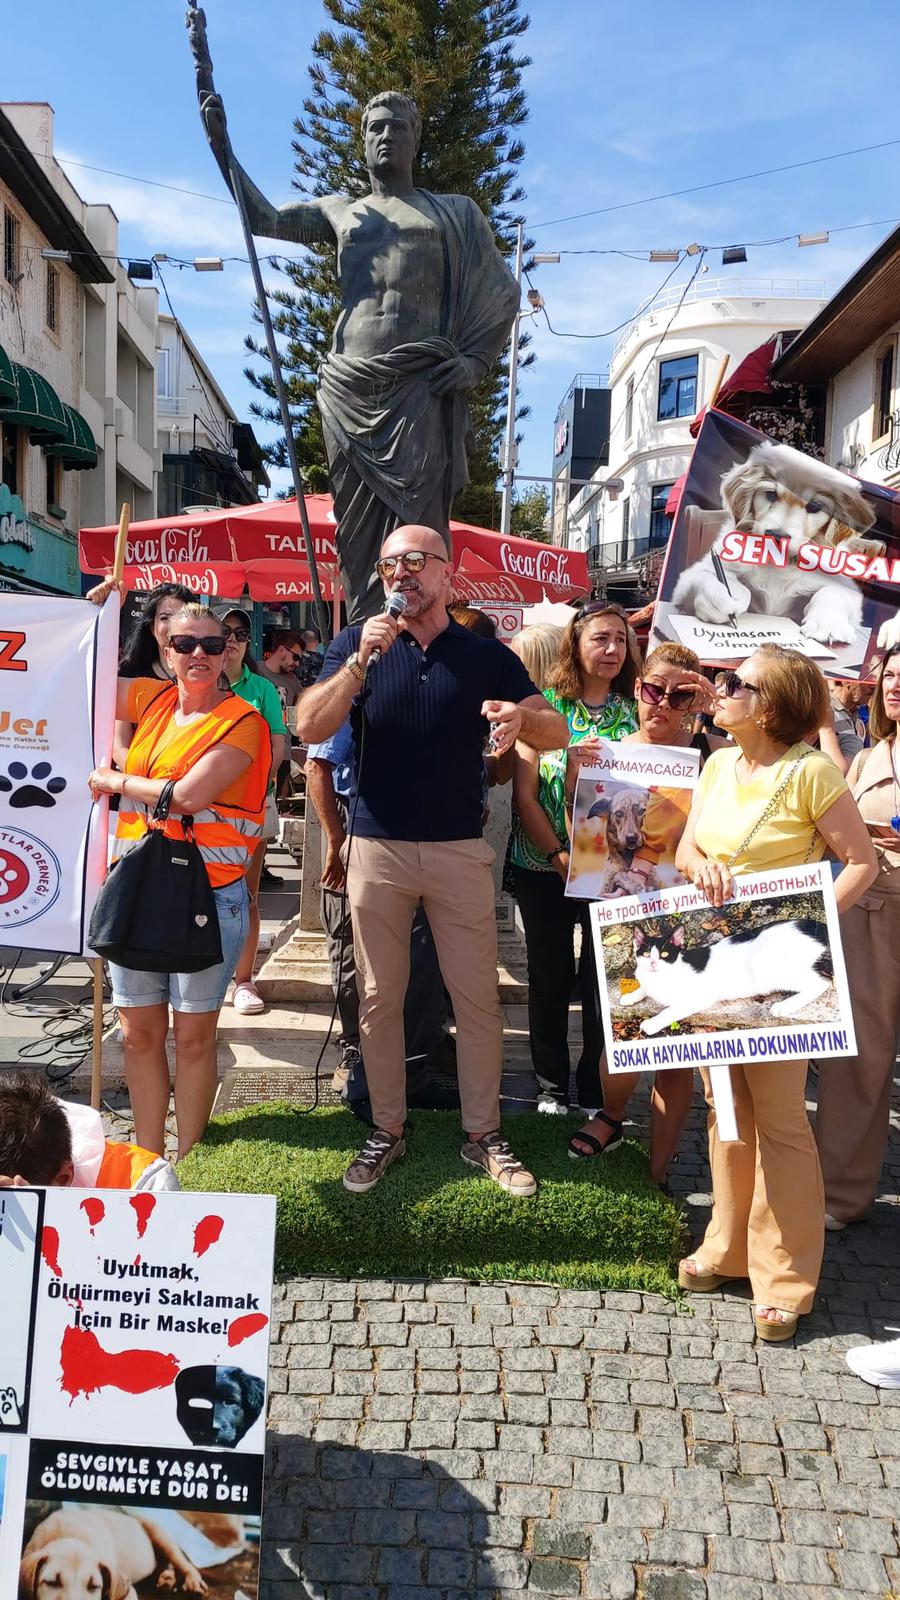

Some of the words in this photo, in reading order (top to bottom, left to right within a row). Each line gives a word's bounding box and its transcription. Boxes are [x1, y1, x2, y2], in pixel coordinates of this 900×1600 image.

[721, 532, 788, 567] SEN
[693, 627, 781, 642] Uyumasam
[597, 907, 613, 921] Не
[616, 898, 670, 919] трогайте
[739, 869, 823, 897] животных!
[613, 1047, 651, 1068] SOKAK
[653, 1038, 746, 1064] HAYVANLARINA
[749, 1030, 849, 1057] DOKUNMAYIN!
[103, 1259, 199, 1282] Uyutmak,
[48, 1278, 151, 1306] Öldürmeyi
[158, 1288, 260, 1310] Saklamak
[119, 1313, 150, 1330] Bir
[157, 1315, 228, 1335] Maske!
[156, 1459, 228, 1482] YAŞAT,
[215, 1483, 249, 1502] DE!
